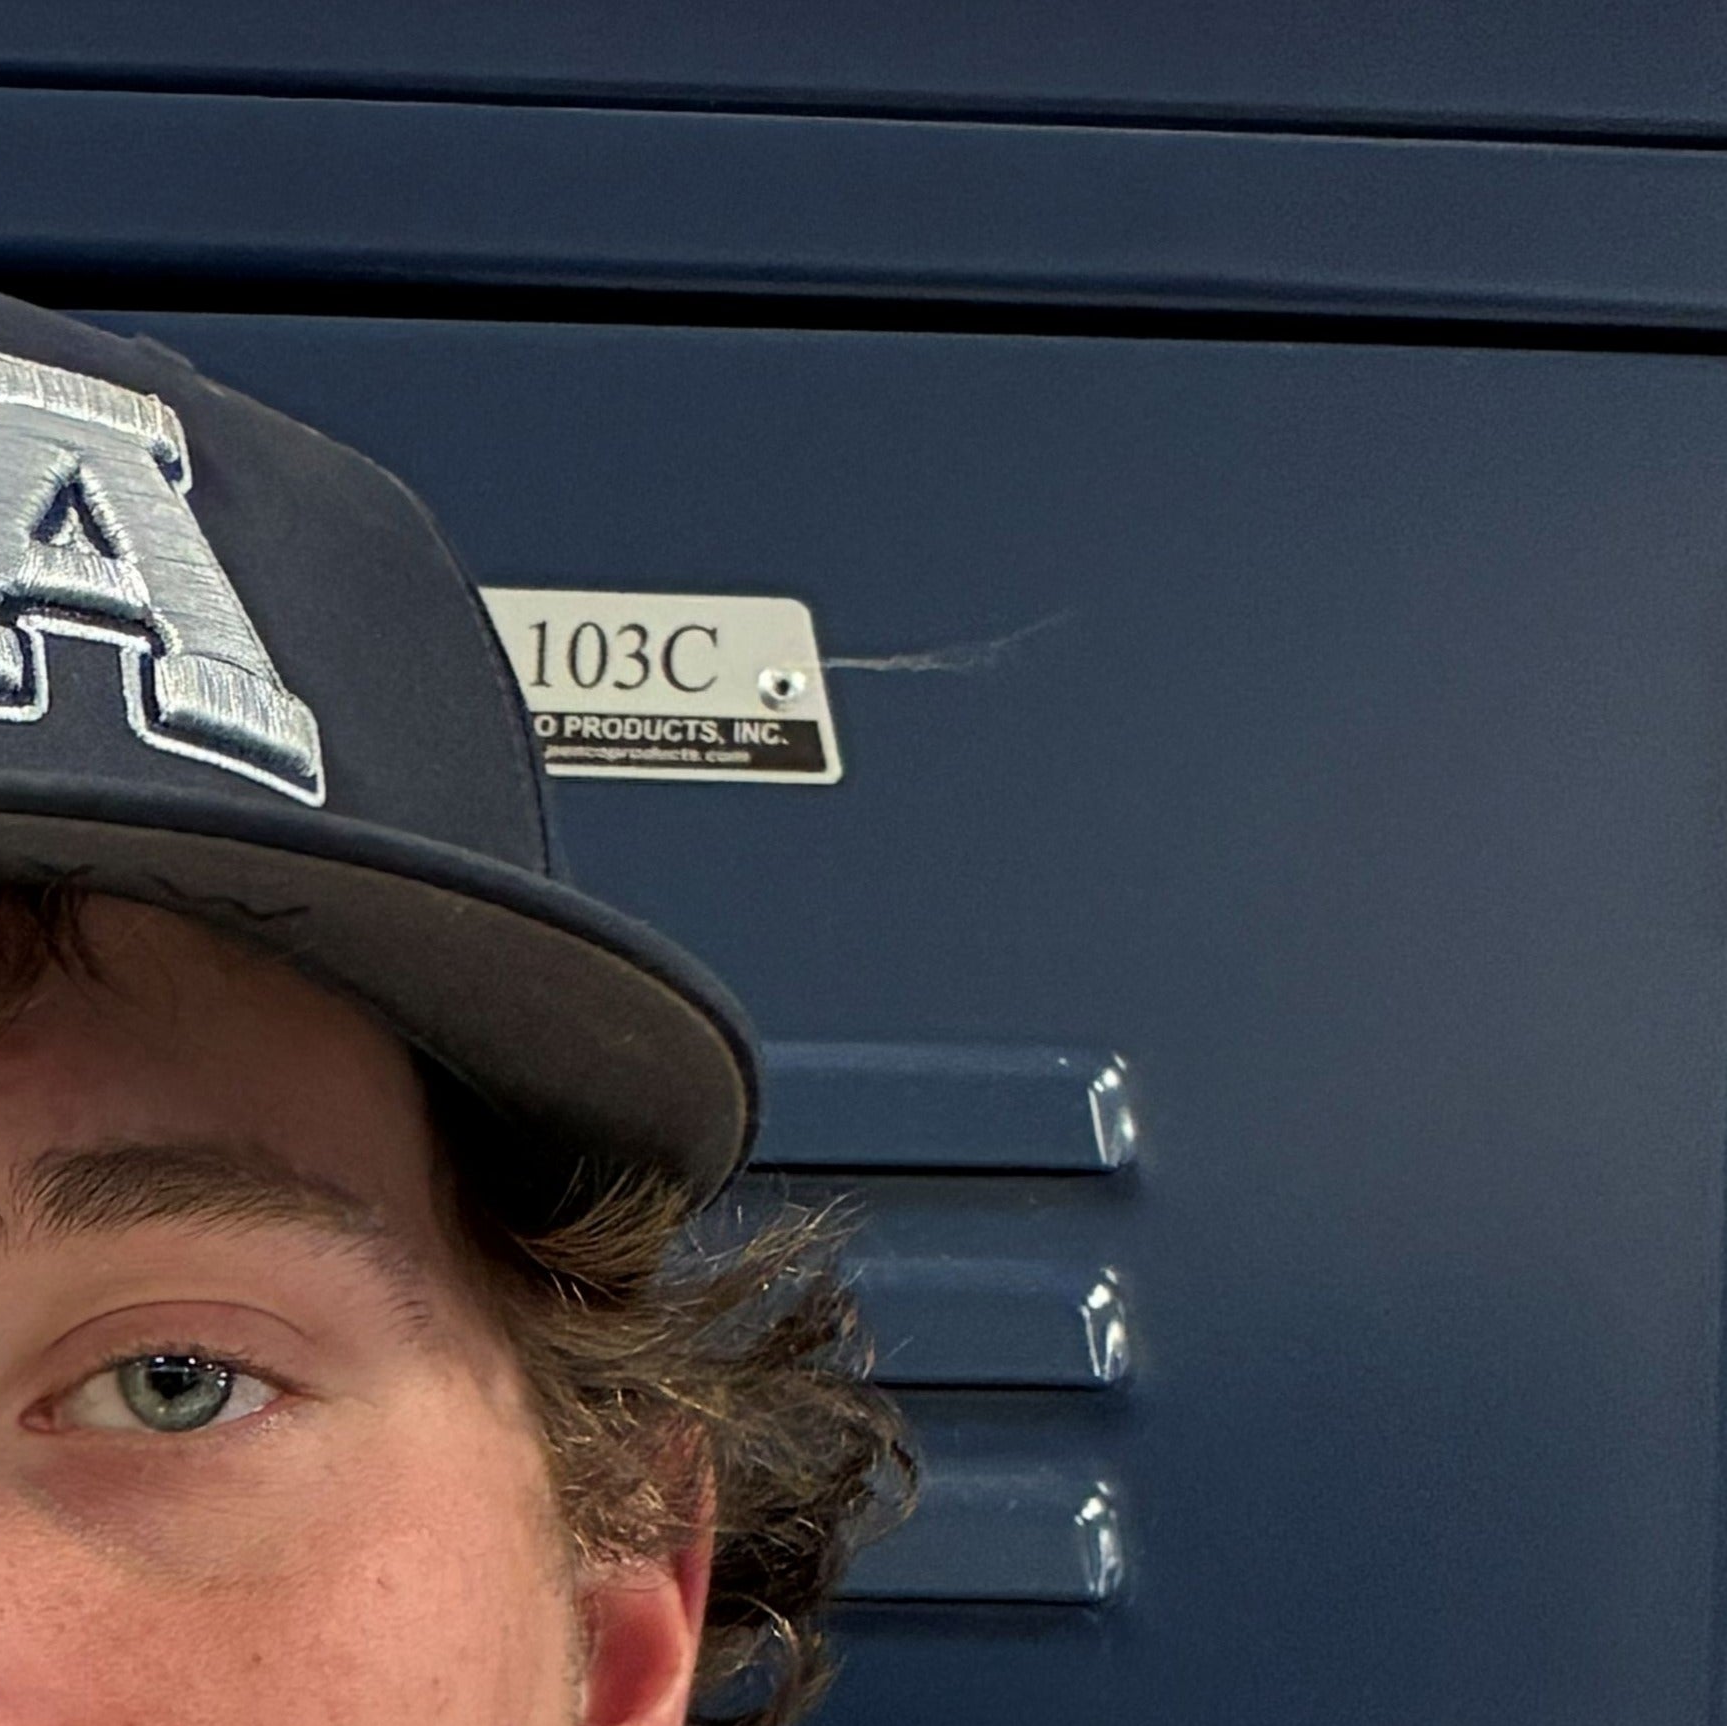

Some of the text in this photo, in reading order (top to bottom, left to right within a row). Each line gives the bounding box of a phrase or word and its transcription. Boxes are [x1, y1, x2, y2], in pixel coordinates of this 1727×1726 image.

[528, 620, 718, 692] 103C
[563, 717, 727, 744] PRODUCTS,
[733, 720, 789, 745] INC.
